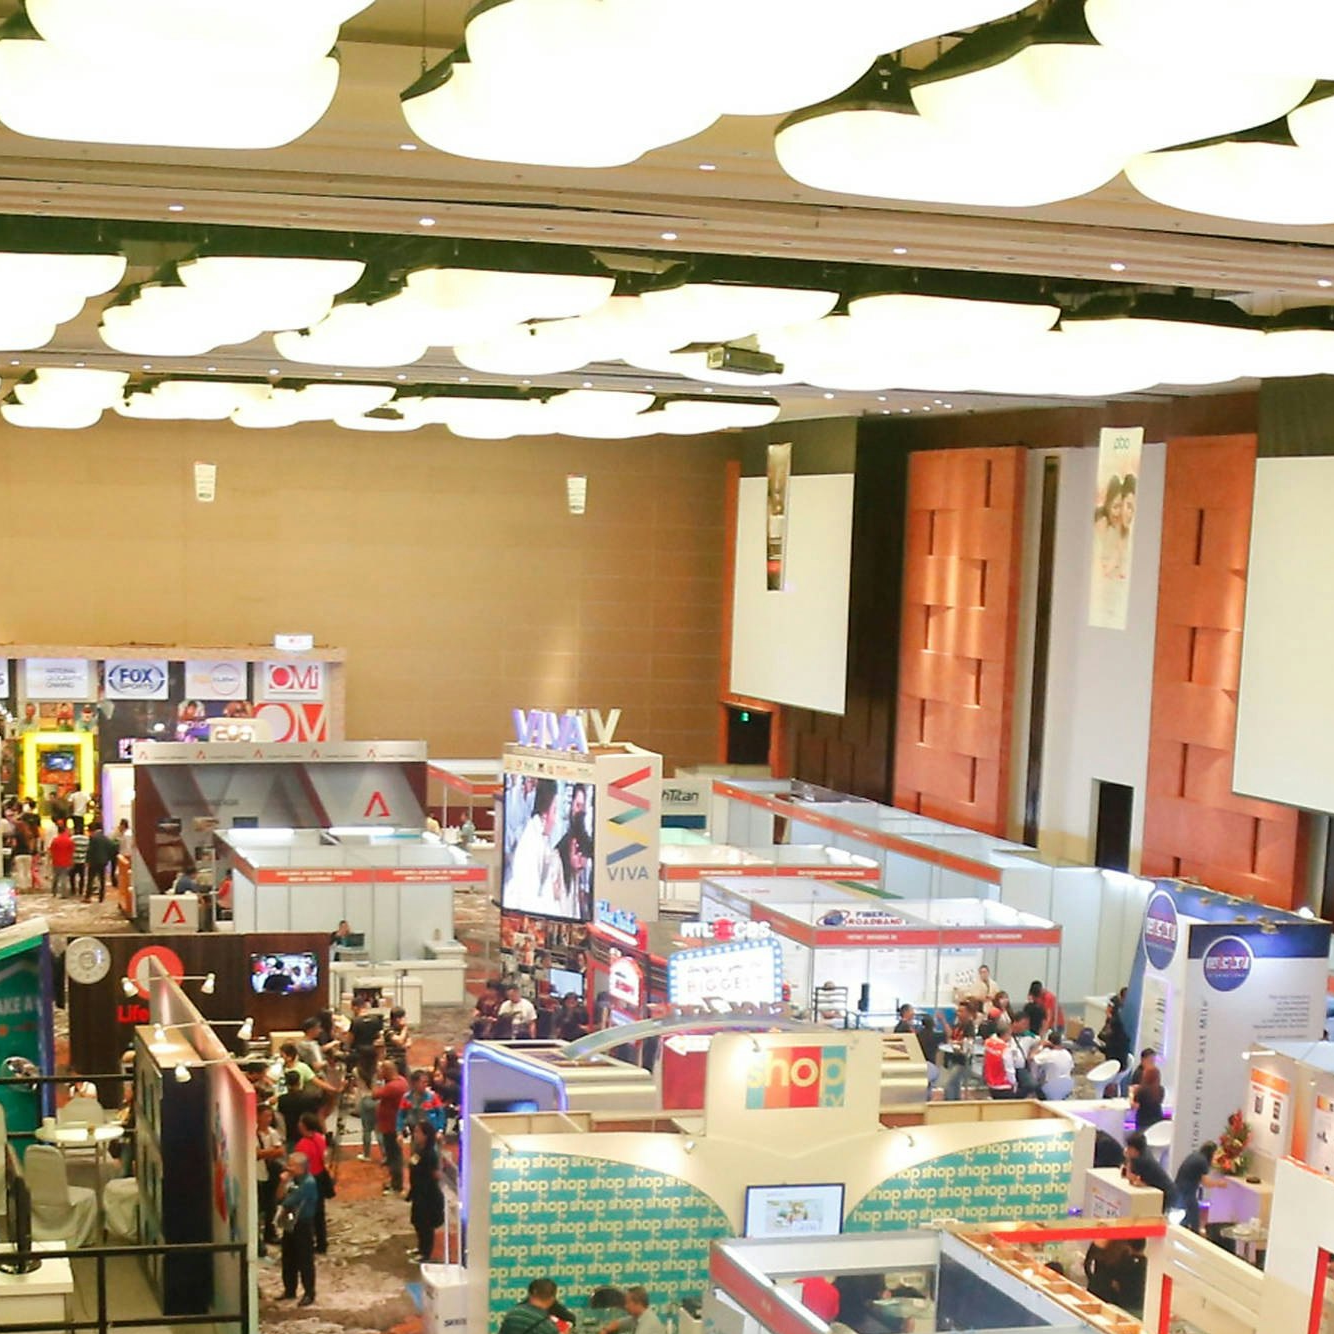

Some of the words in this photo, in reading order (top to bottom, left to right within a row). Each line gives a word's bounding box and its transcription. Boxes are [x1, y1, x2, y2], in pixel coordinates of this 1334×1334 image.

[118, 668, 152, 683] FOX
[512, 708, 589, 755] VIVA
[607, 867, 649, 881] VIVA
[733, 921, 771, 938] CBS
[688, 976, 766, 993] BIGGET
[117, 1005, 150, 1022] Life
[1197, 1035, 1206, 1063] Last
[747, 1049, 847, 1102] shop
[977, 1143, 1009, 1157] shop
[1013, 1140, 1045, 1155] shop
[923, 1165, 955, 1179] shop
[958, 1164, 990, 1178] shop
[993, 1162, 1025, 1176] shop
[1028, 1160, 1060, 1175] shop
[512, 1179, 548, 1194] shop
[551, 1178, 587, 1193] shop
[590, 1177, 625, 1192] shop
[628, 1176, 663, 1190] shop
[868, 1187, 901, 1201] shop
[904, 1186, 936, 1200] shop
[939, 1184, 971, 1199] shop
[974, 1183, 1007, 1198] shop
[1009, 1182, 1042, 1197] shop
[512, 1223, 547, 1239] shop
[550, 1221, 586, 1237] shop
[588, 1220, 623, 1236] shop
[626, 1219, 661, 1233] shop
[511, 1266, 546, 1280] shop
[549, 1264, 585, 1279] shop
[587, 1262, 623, 1278] shop
[625, 1261, 660, 1276] shop
